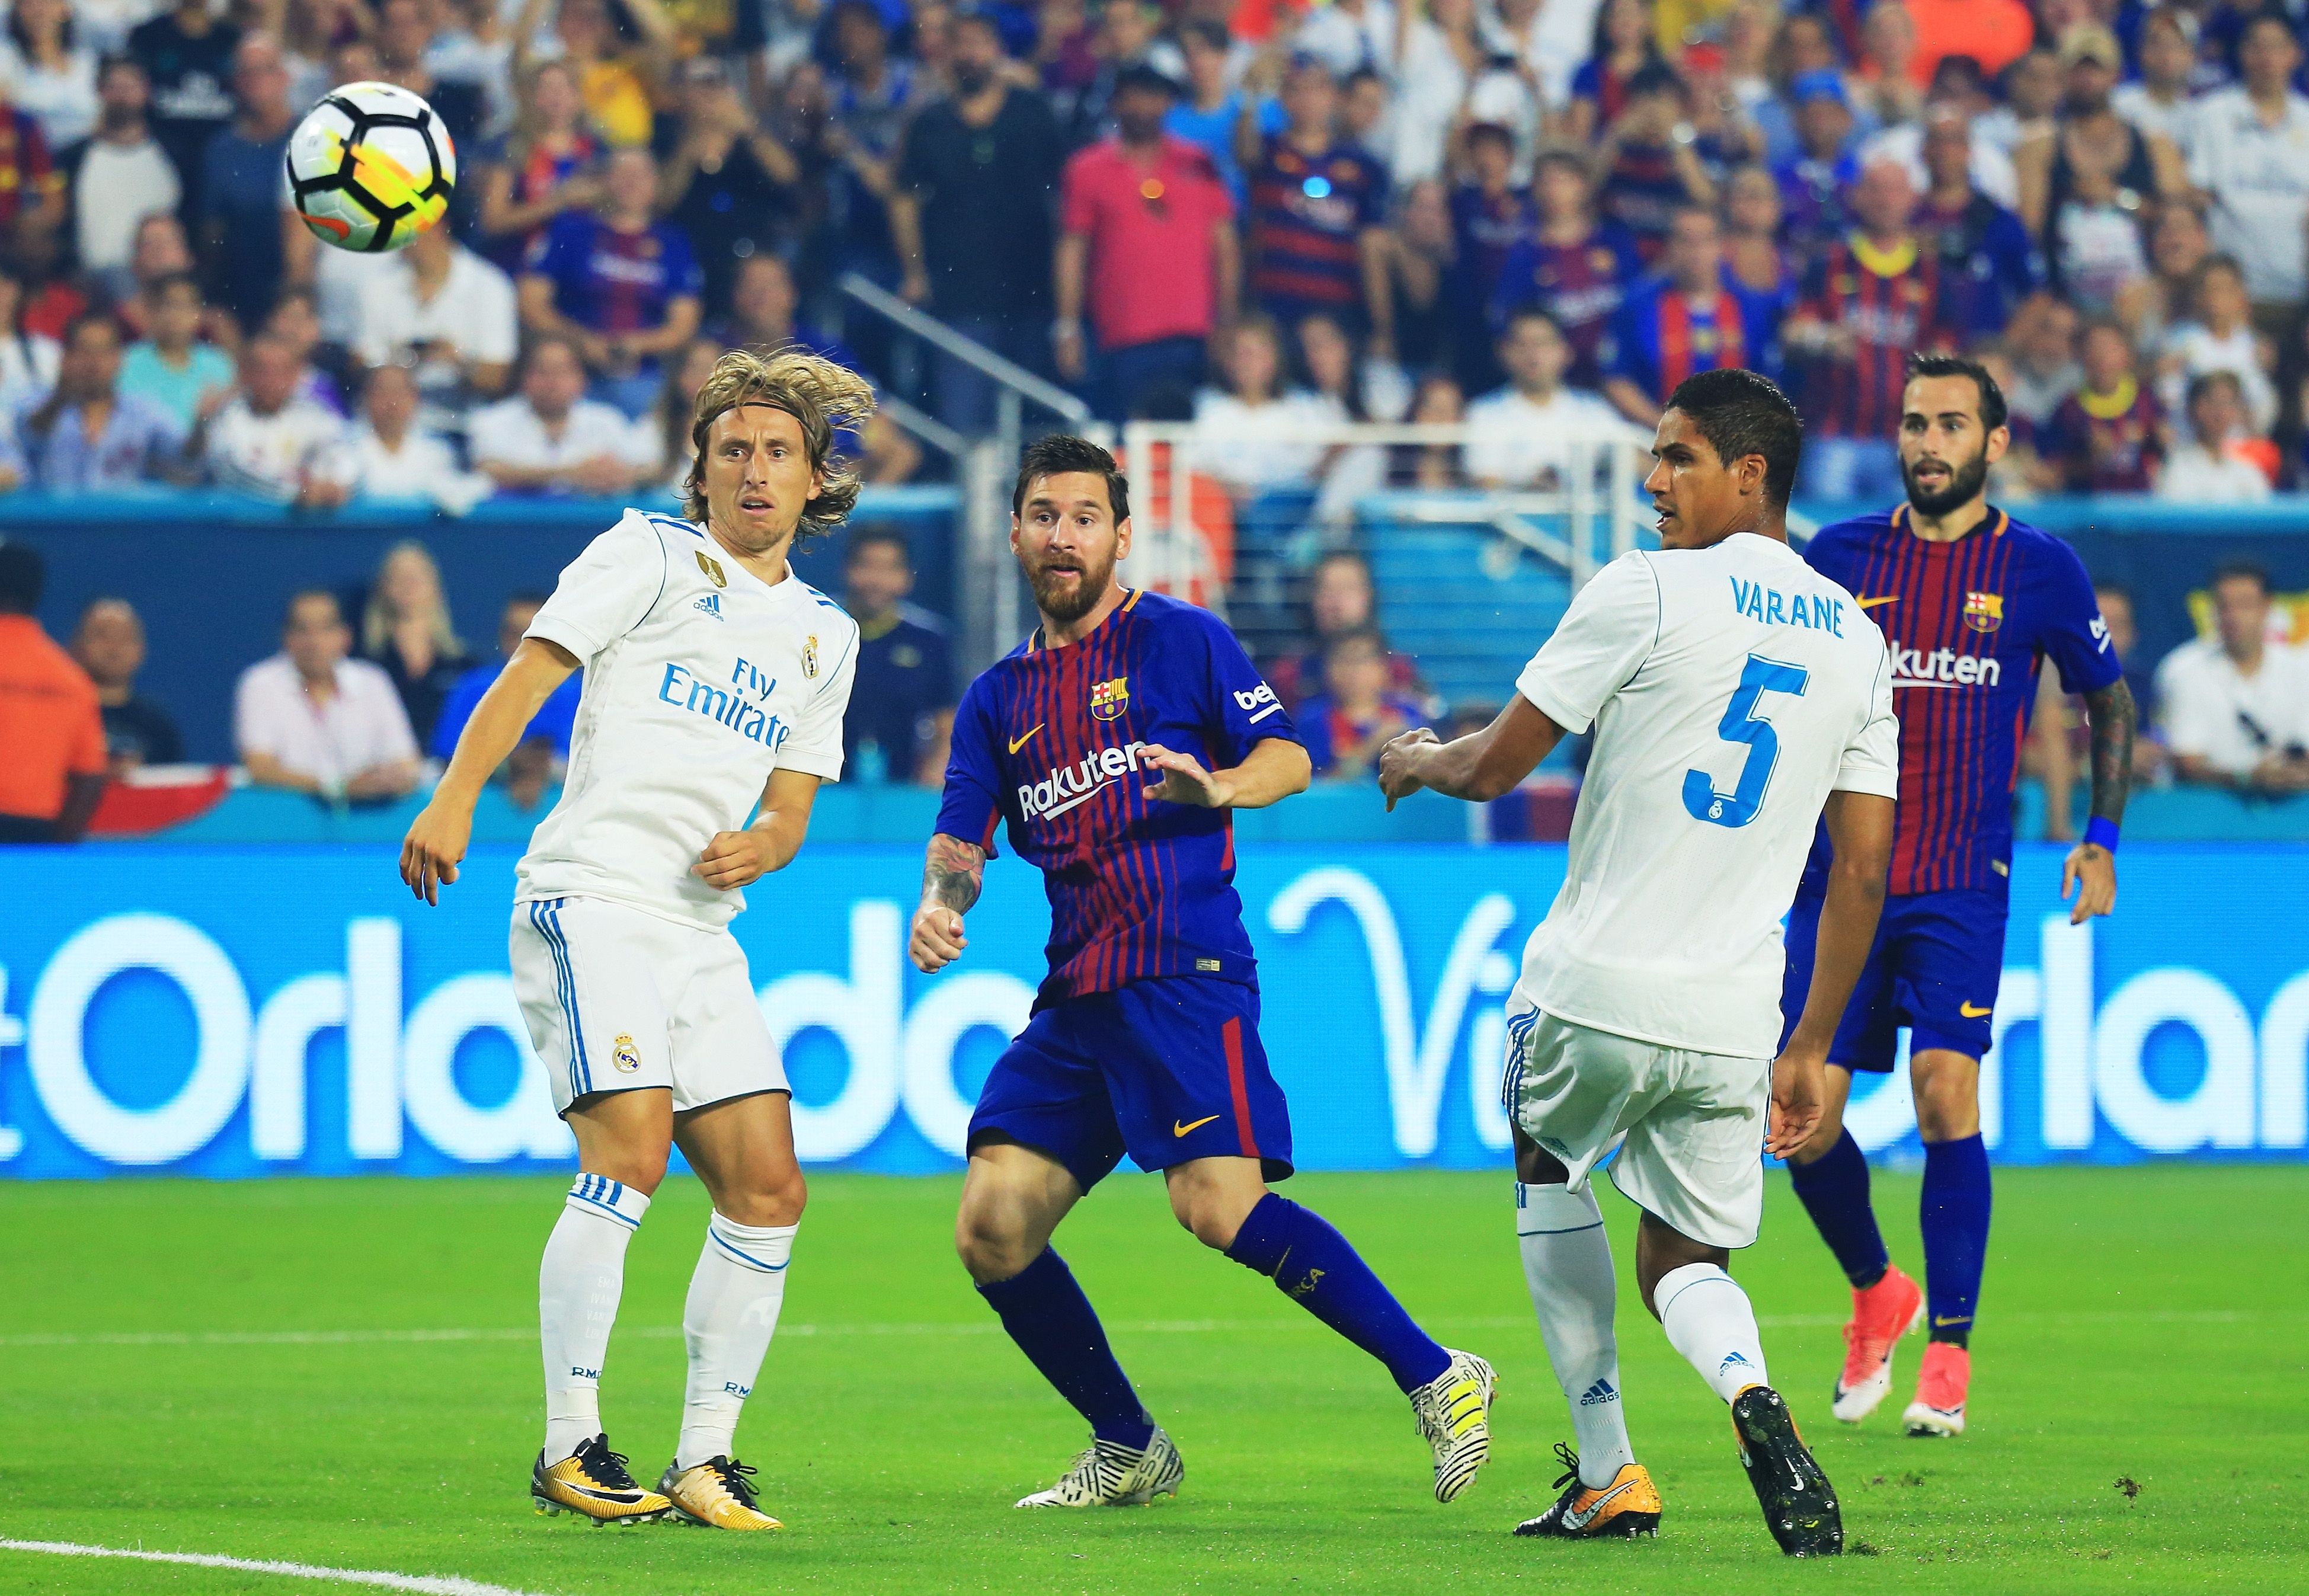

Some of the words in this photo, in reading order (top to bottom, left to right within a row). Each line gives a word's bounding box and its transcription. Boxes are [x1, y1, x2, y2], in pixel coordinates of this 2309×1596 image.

[693, 602, 724, 622] adidas
[1730, 575, 1844, 638] VARANE
[732, 657, 776, 701] Fly
[1890, 641, 2000, 686] kuten
[659, 663, 789, 754] Emirate
[1682, 653, 1810, 828] 5
[1018, 741, 1151, 822] Rakuten
[1580, 1392, 1620, 1405] adidas
